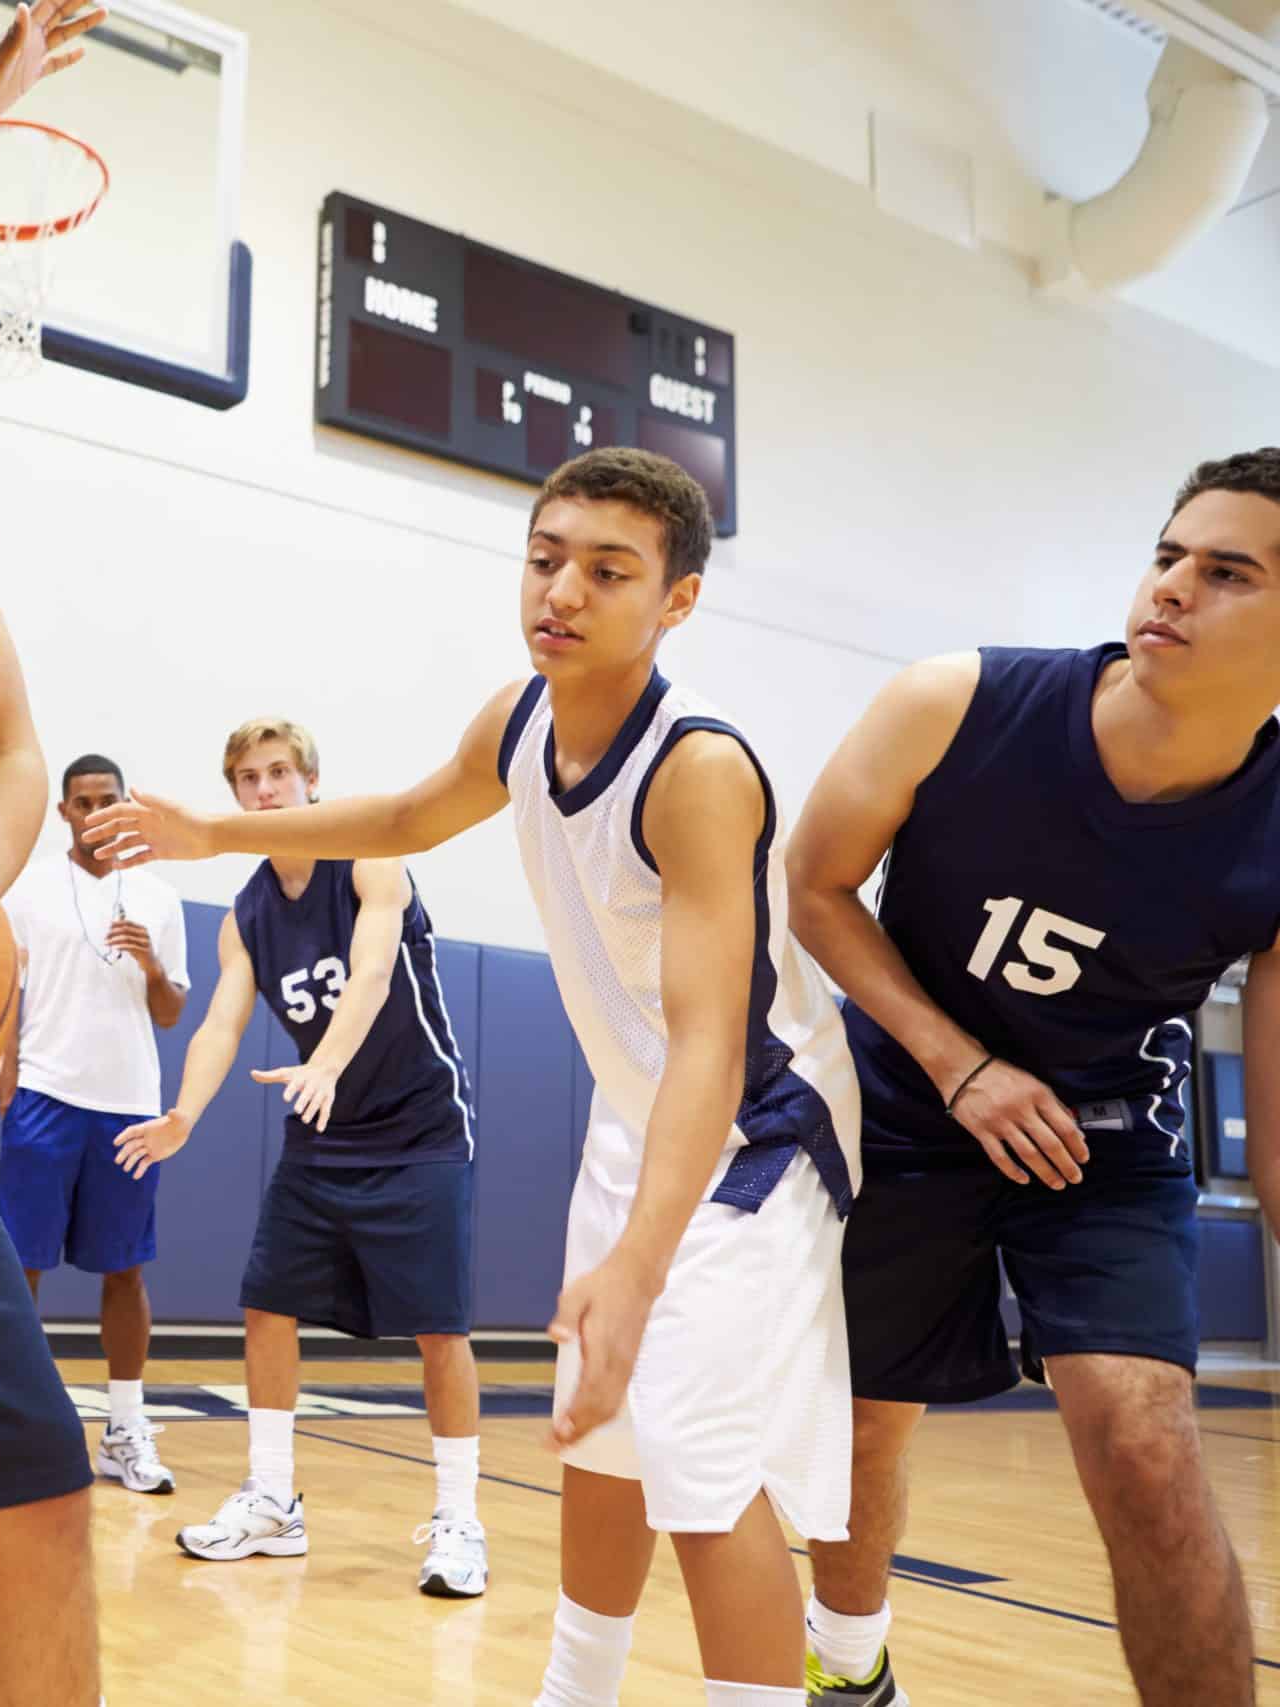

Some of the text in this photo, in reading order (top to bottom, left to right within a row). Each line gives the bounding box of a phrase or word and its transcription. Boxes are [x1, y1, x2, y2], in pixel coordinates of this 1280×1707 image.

[365, 276, 438, 333] HOME
[650, 373, 716, 424] GUEST
[966, 896, 1107, 996] 15
[281, 956, 348, 1024] 53
